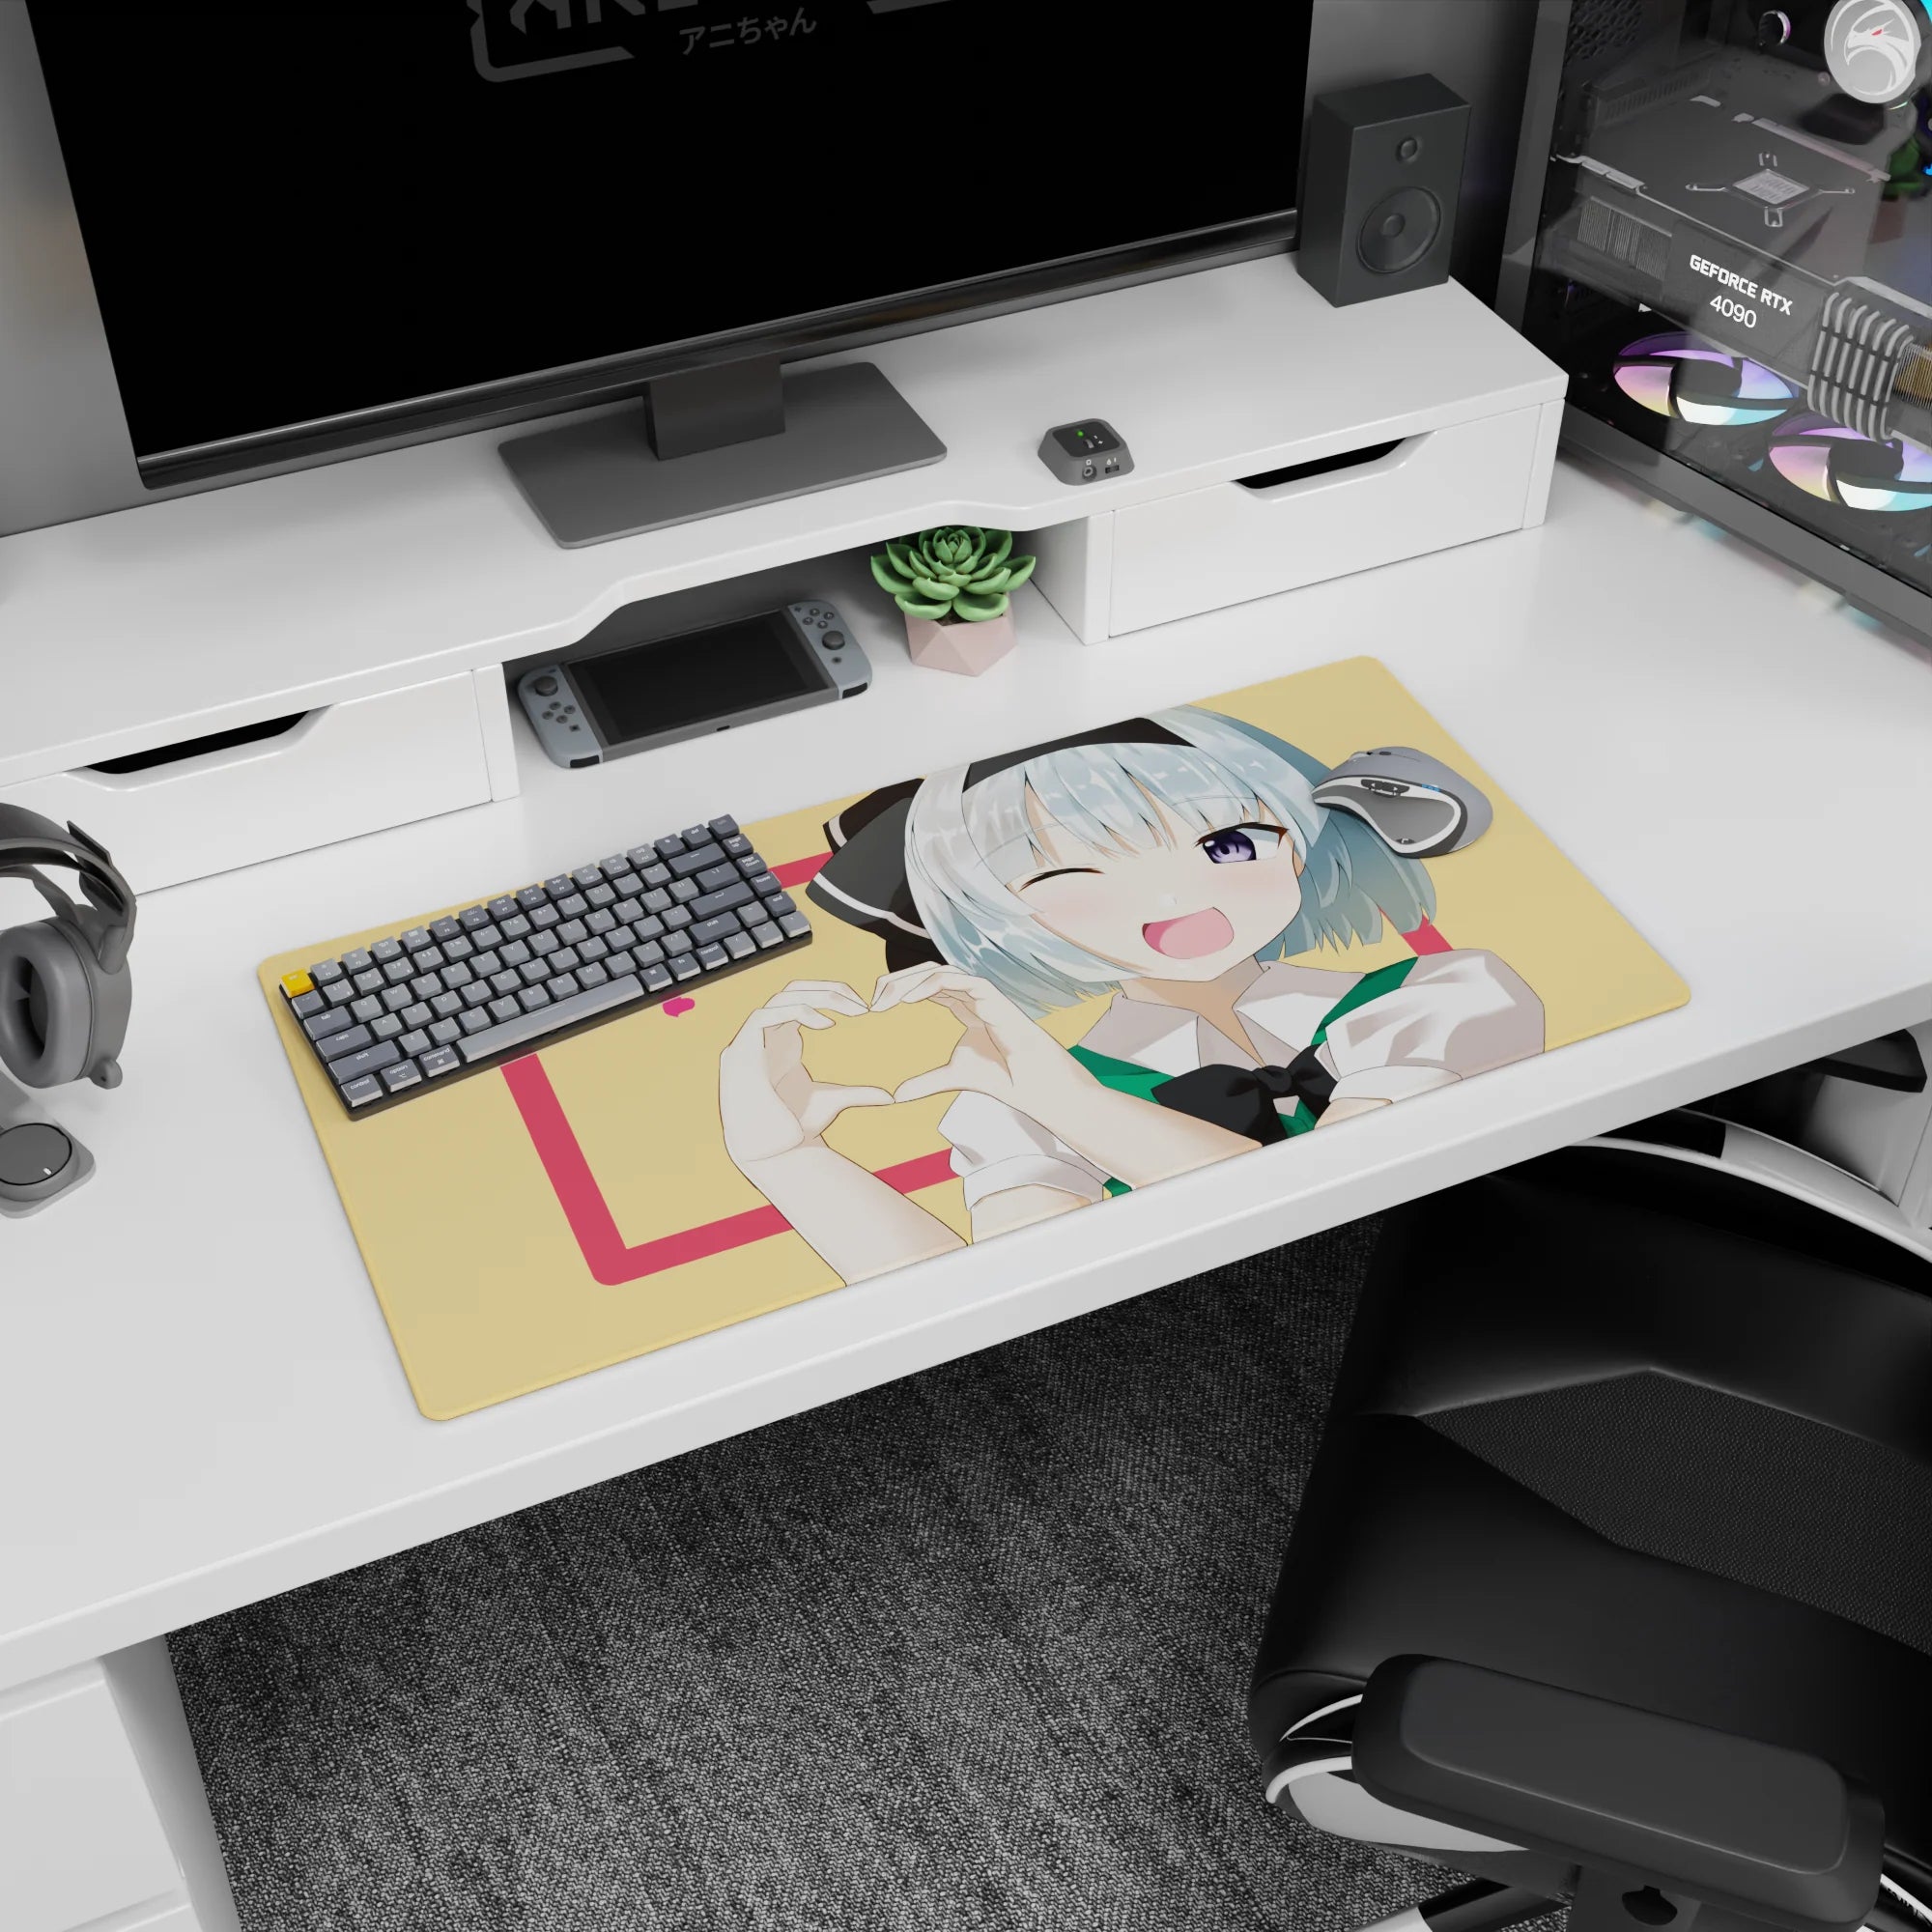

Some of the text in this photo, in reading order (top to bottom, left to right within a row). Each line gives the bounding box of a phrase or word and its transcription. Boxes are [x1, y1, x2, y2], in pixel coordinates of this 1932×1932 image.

[679, 7, 817, 55] アニちゃん
[1690, 254, 1793, 316] GEFORCE RTX
[1710, 295, 1757, 328] 4090
[423, 1048, 450, 1061] command
[389, 1065, 408, 1074] option
[351, 1079, 370, 1090] control
